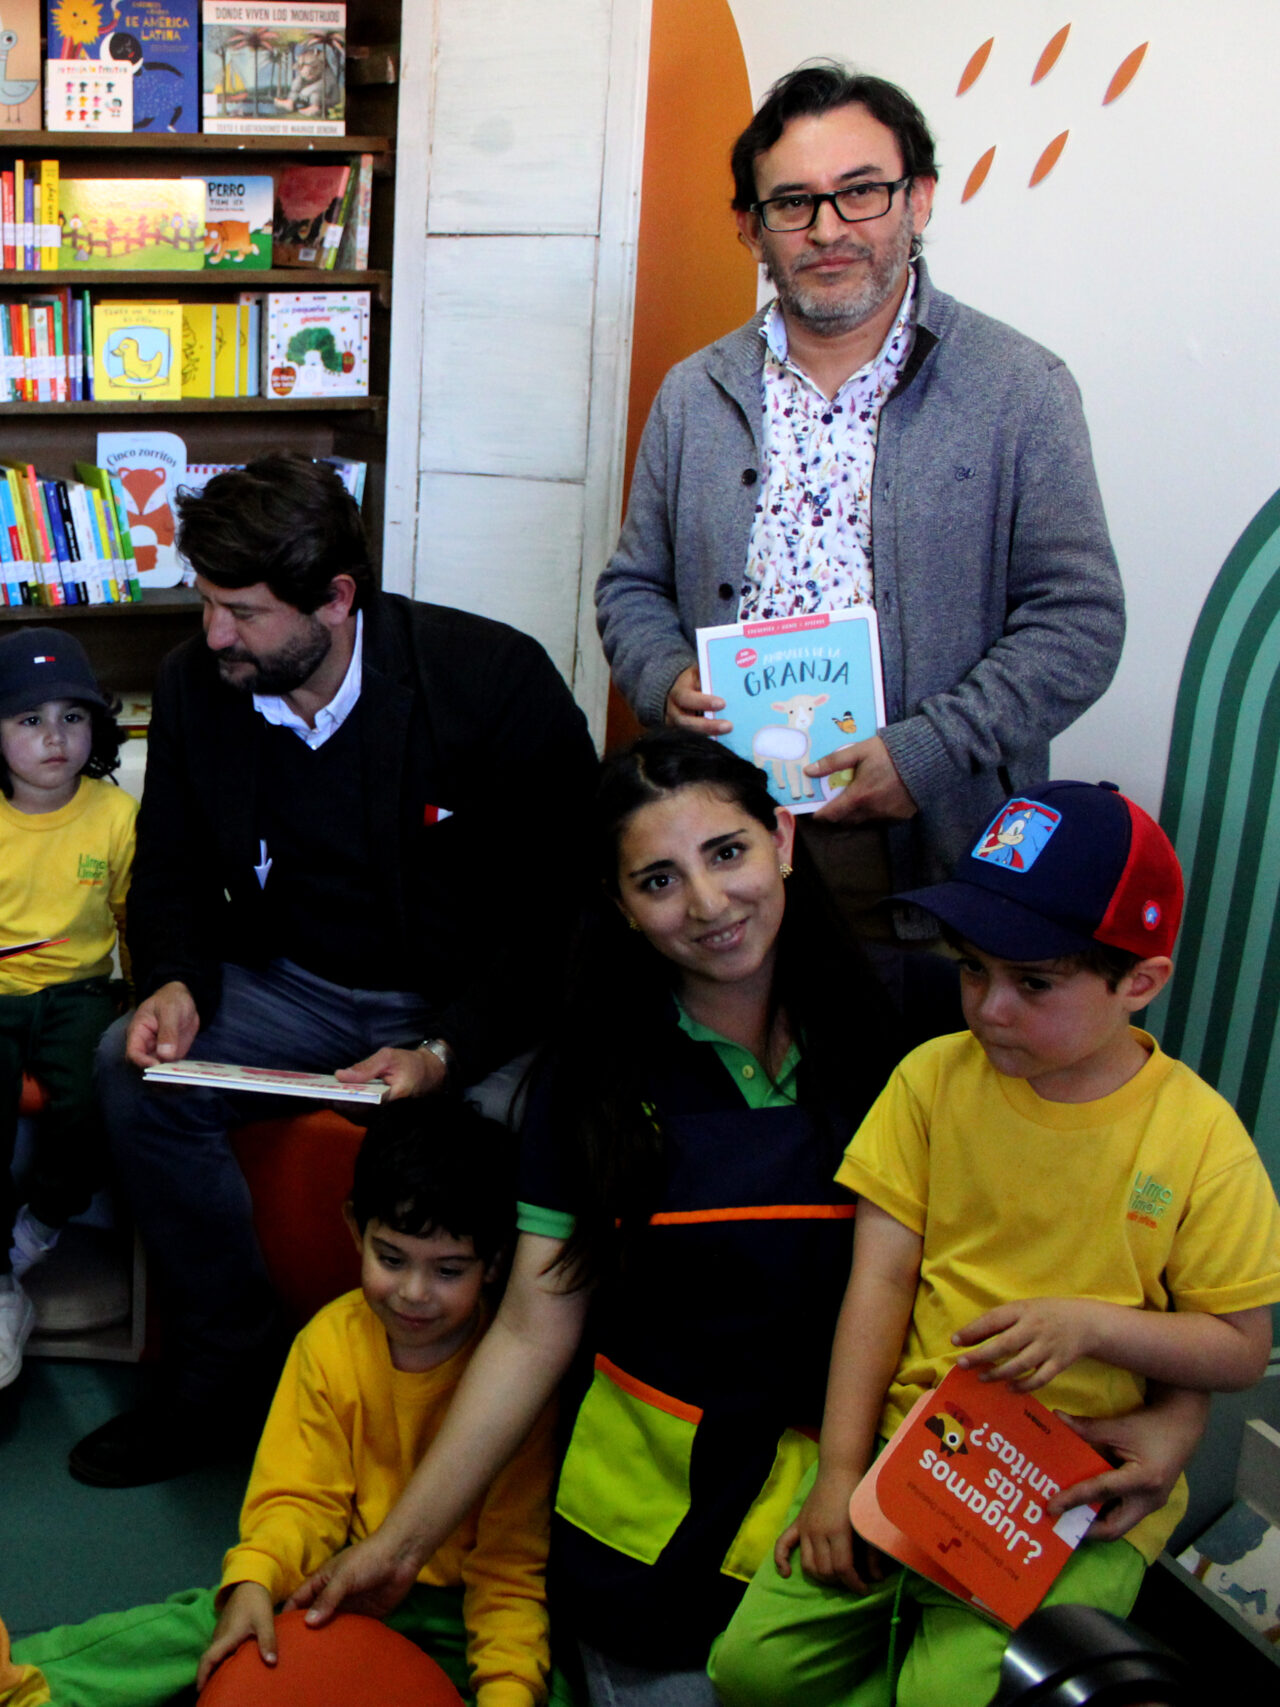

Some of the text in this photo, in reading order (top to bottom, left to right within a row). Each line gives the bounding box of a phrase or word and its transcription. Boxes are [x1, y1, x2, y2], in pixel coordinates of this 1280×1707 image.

[216, 7, 242, 20] DONDE
[245, 8, 270, 20] VIVEN
[273, 9, 288, 21] LOS
[208, 182, 246, 197] PERRO
[291, 305, 325, 315] pequeña
[327, 306, 352, 314] oruga
[106, 448, 177, 468] Cinco zorritos
[743, 658, 849, 697] GRANJA
[970, 1422, 1061, 1501] anitas?
[918, 1448, 1043, 1565] ¿Jugamos
[984, 1467, 1043, 1525] a las
